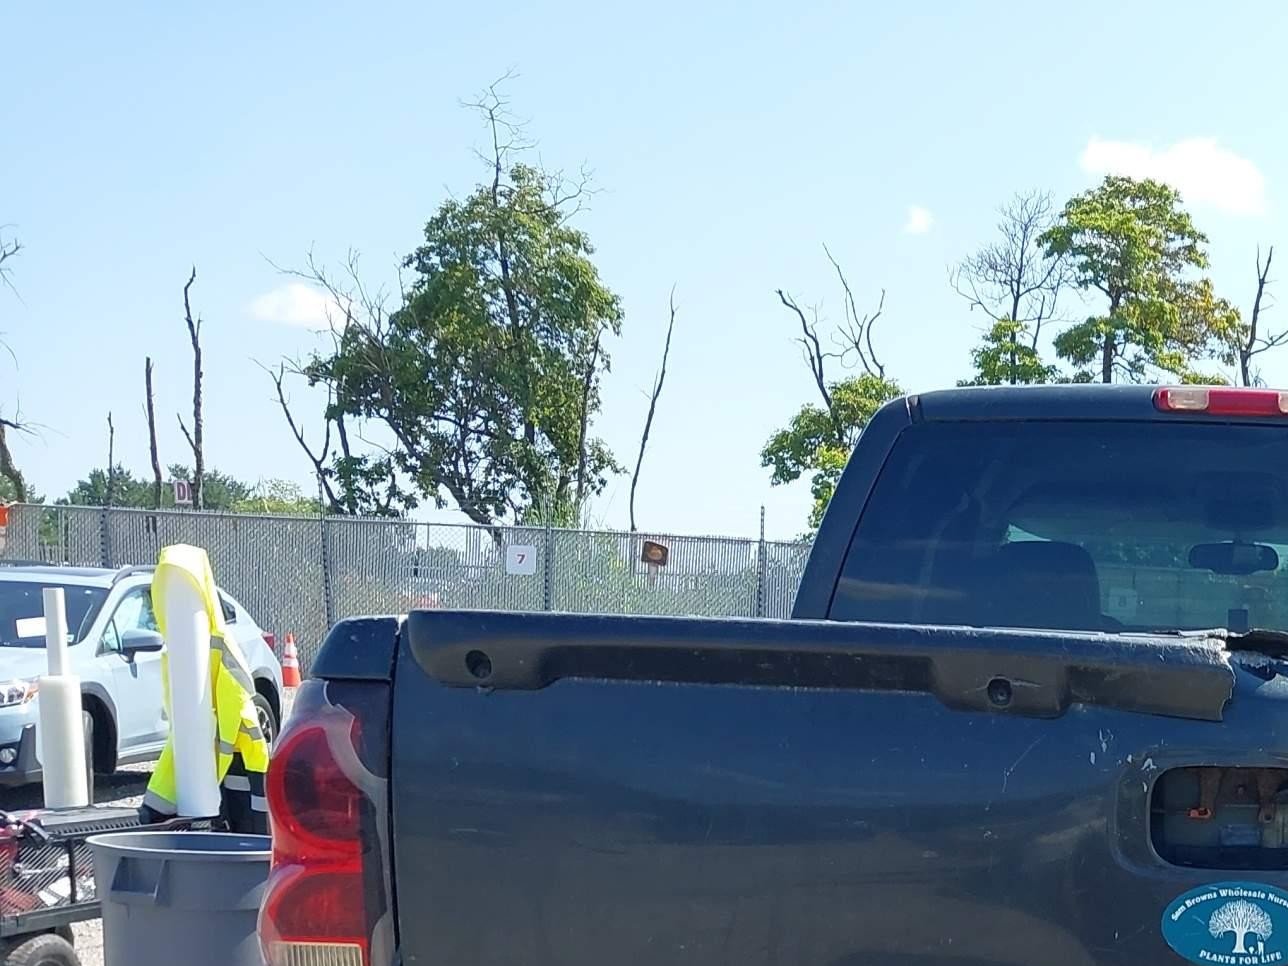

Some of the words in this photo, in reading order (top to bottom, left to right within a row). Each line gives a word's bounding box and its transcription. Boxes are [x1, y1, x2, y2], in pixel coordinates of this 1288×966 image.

[517, 554, 526, 565] 7
[1171, 905, 1187, 921] Sam
[1185, 892, 1218, 908] Browns
[1219, 888, 1266, 899] Wholesale
[1199, 949, 1236, 965] PLANTS
[1239, 955, 1259, 965] FOR
[1261, 951, 1283, 963] LIFE
